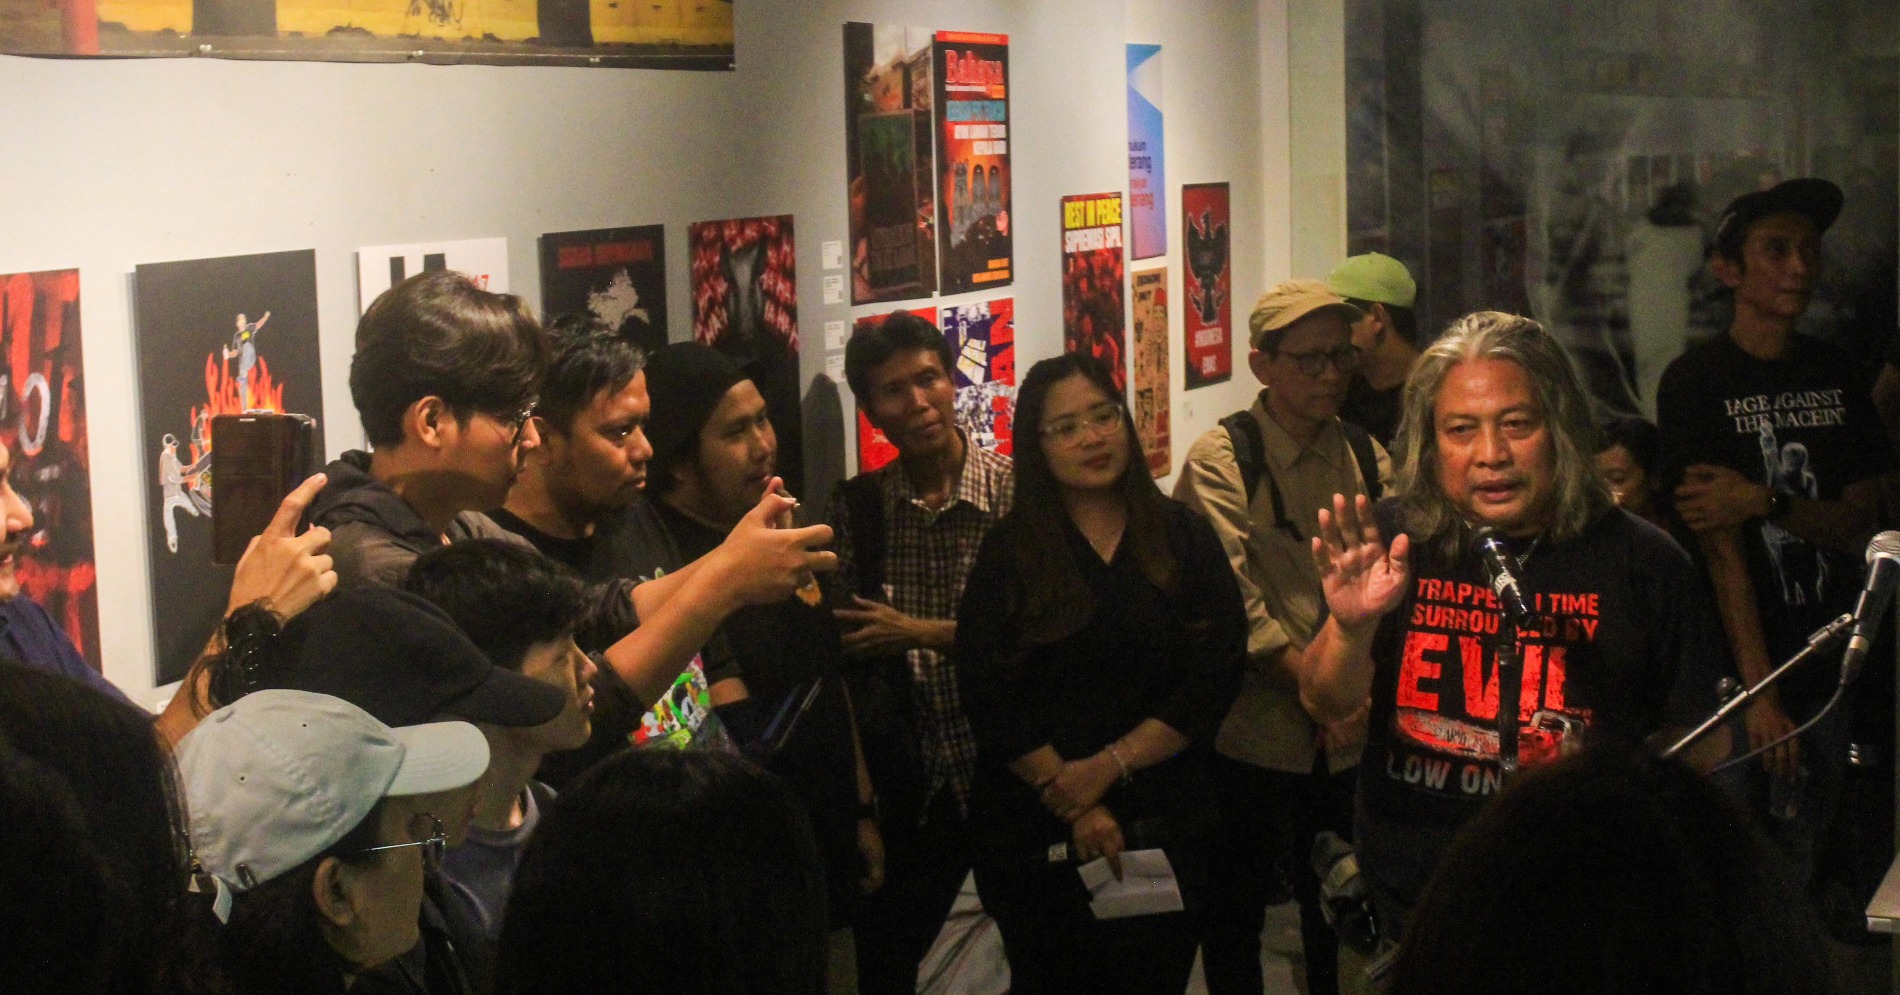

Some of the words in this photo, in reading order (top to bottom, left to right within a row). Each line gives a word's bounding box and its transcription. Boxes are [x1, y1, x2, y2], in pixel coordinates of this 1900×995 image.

[1065, 200, 1084, 228] REST
[1086, 200, 1095, 226] IN
[1097, 197, 1122, 225] PEACE
[1774, 389, 1843, 409] AGAINST
[1735, 414, 1769, 433] THE
[1774, 408, 1847, 428] MACHIN
[1418, 578, 1503, 609] TRAPPE
[1549, 593, 1600, 616] TIME
[1564, 617, 1599, 641] BY
[1396, 631, 1592, 727] EVIL
[1388, 752, 1451, 790] LOW
[1462, 762, 1502, 796] ON
